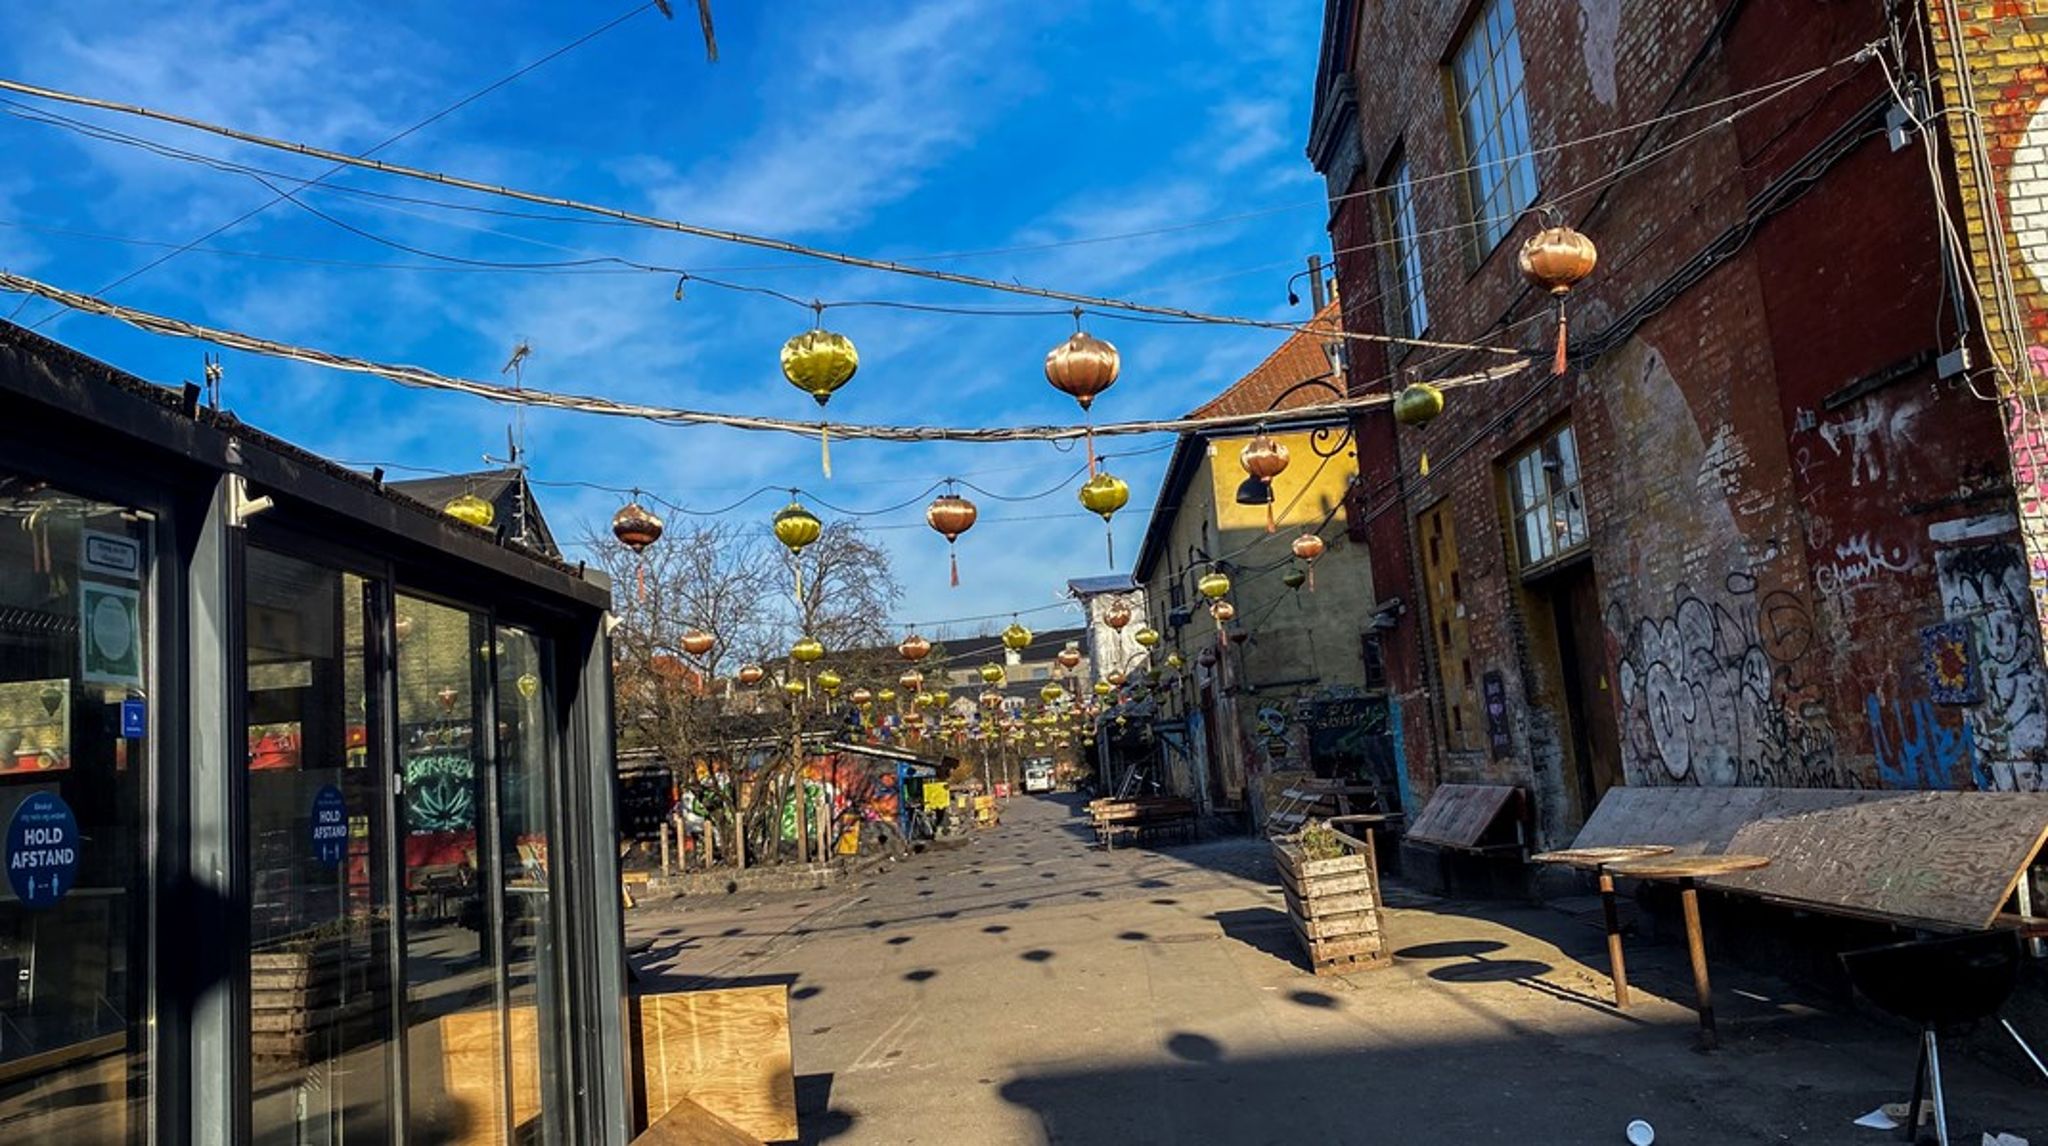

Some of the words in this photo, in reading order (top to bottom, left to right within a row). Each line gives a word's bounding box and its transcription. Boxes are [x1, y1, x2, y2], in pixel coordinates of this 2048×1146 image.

[319, 810, 341, 823] HOLD
[24, 828, 63, 845] HOLD
[313, 826, 347, 840] AFSTAND
[11, 849, 74, 868] AFSTAND
